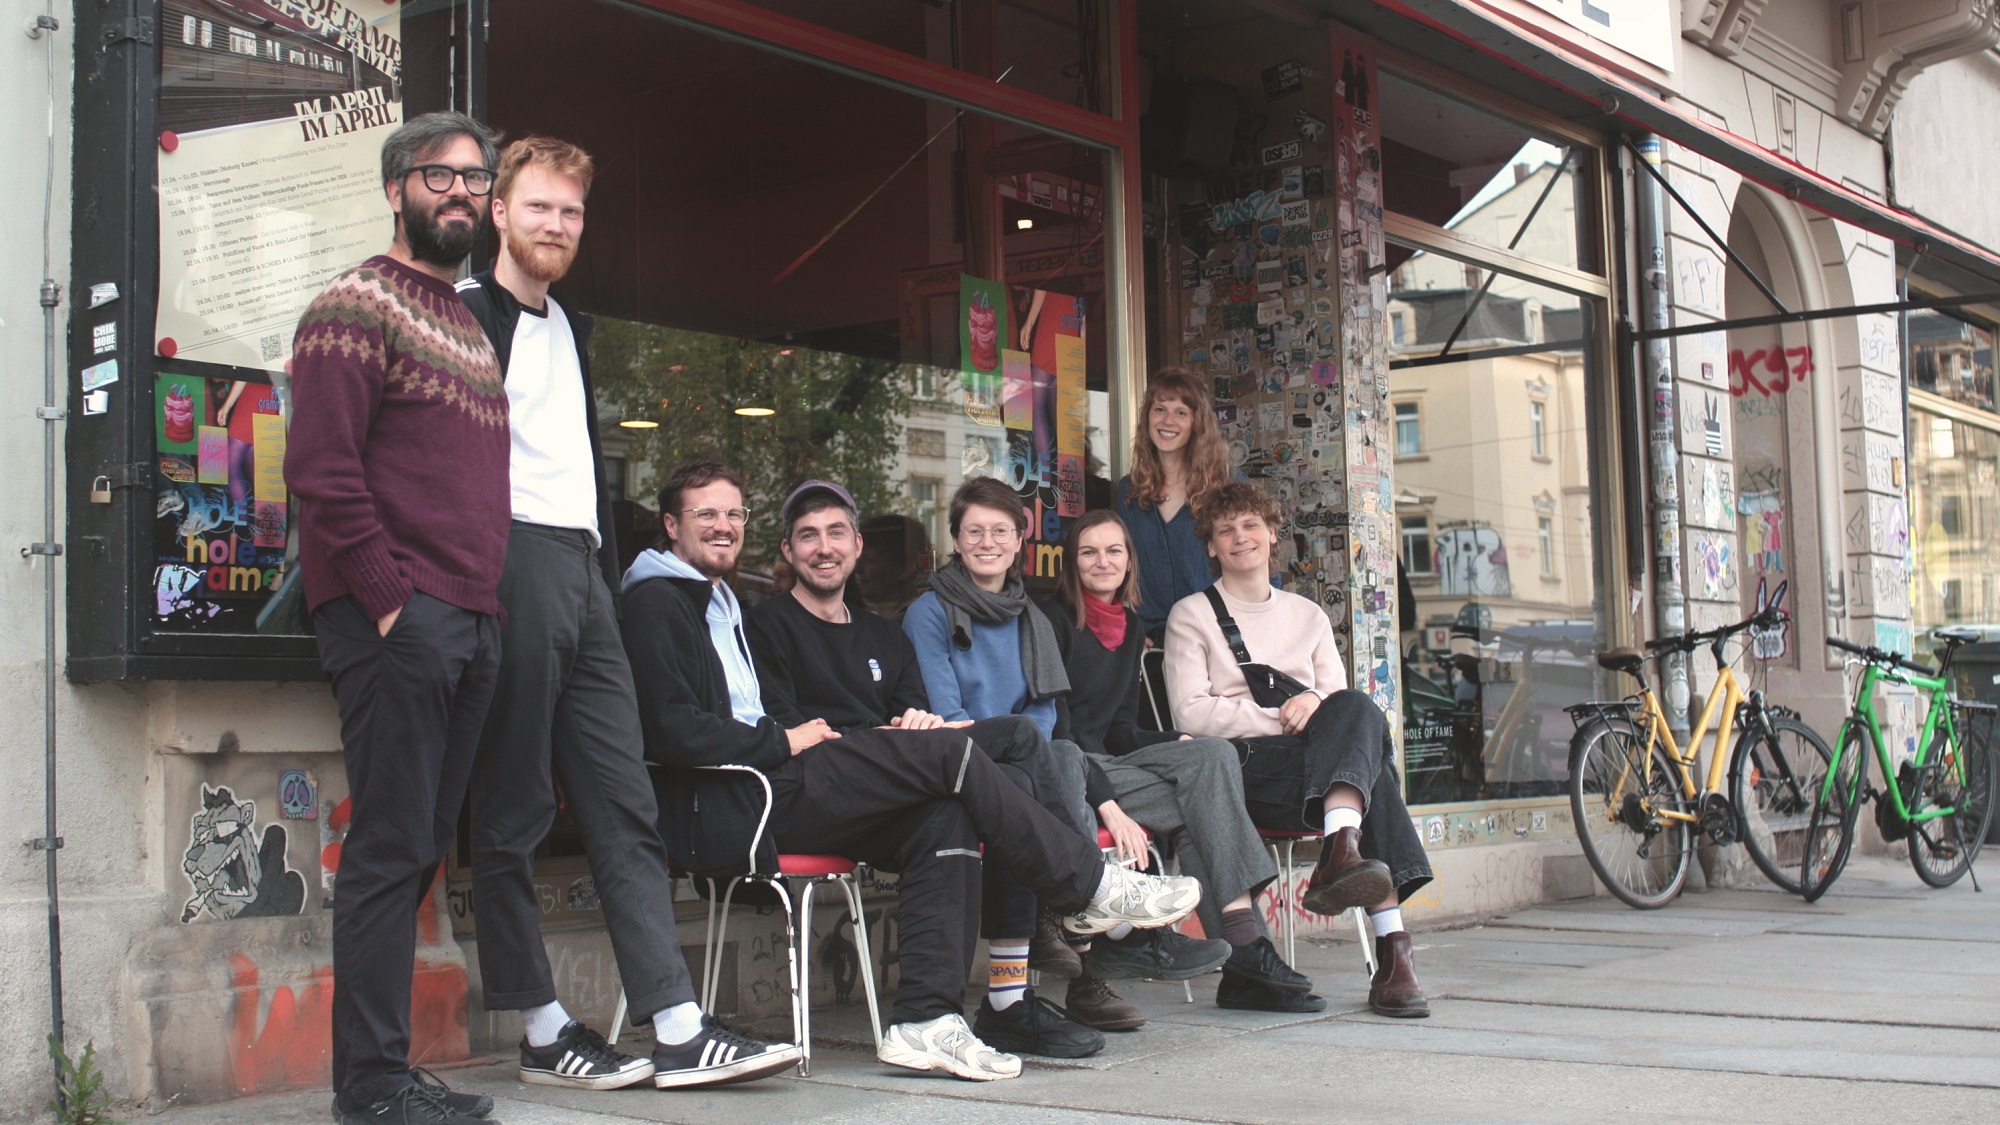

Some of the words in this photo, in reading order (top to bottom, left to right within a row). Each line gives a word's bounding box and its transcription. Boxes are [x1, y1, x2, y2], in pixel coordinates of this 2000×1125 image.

[300, 117, 329, 142] IM
[335, 103, 397, 135] APRIL
[202, 176, 230, 188] Vernissage
[209, 200, 221, 209] Tanz
[1312, 229, 1333, 241] 0228
[94, 334, 116, 348] MORE
[1023, 497, 1060, 542] ole
[186, 531, 256, 565] hole
[1404, 728, 1422, 740] HOLE
[1424, 727, 1433, 738] OF
[1435, 725, 1453, 738] FAME
[990, 965, 1025, 977] SPAM
